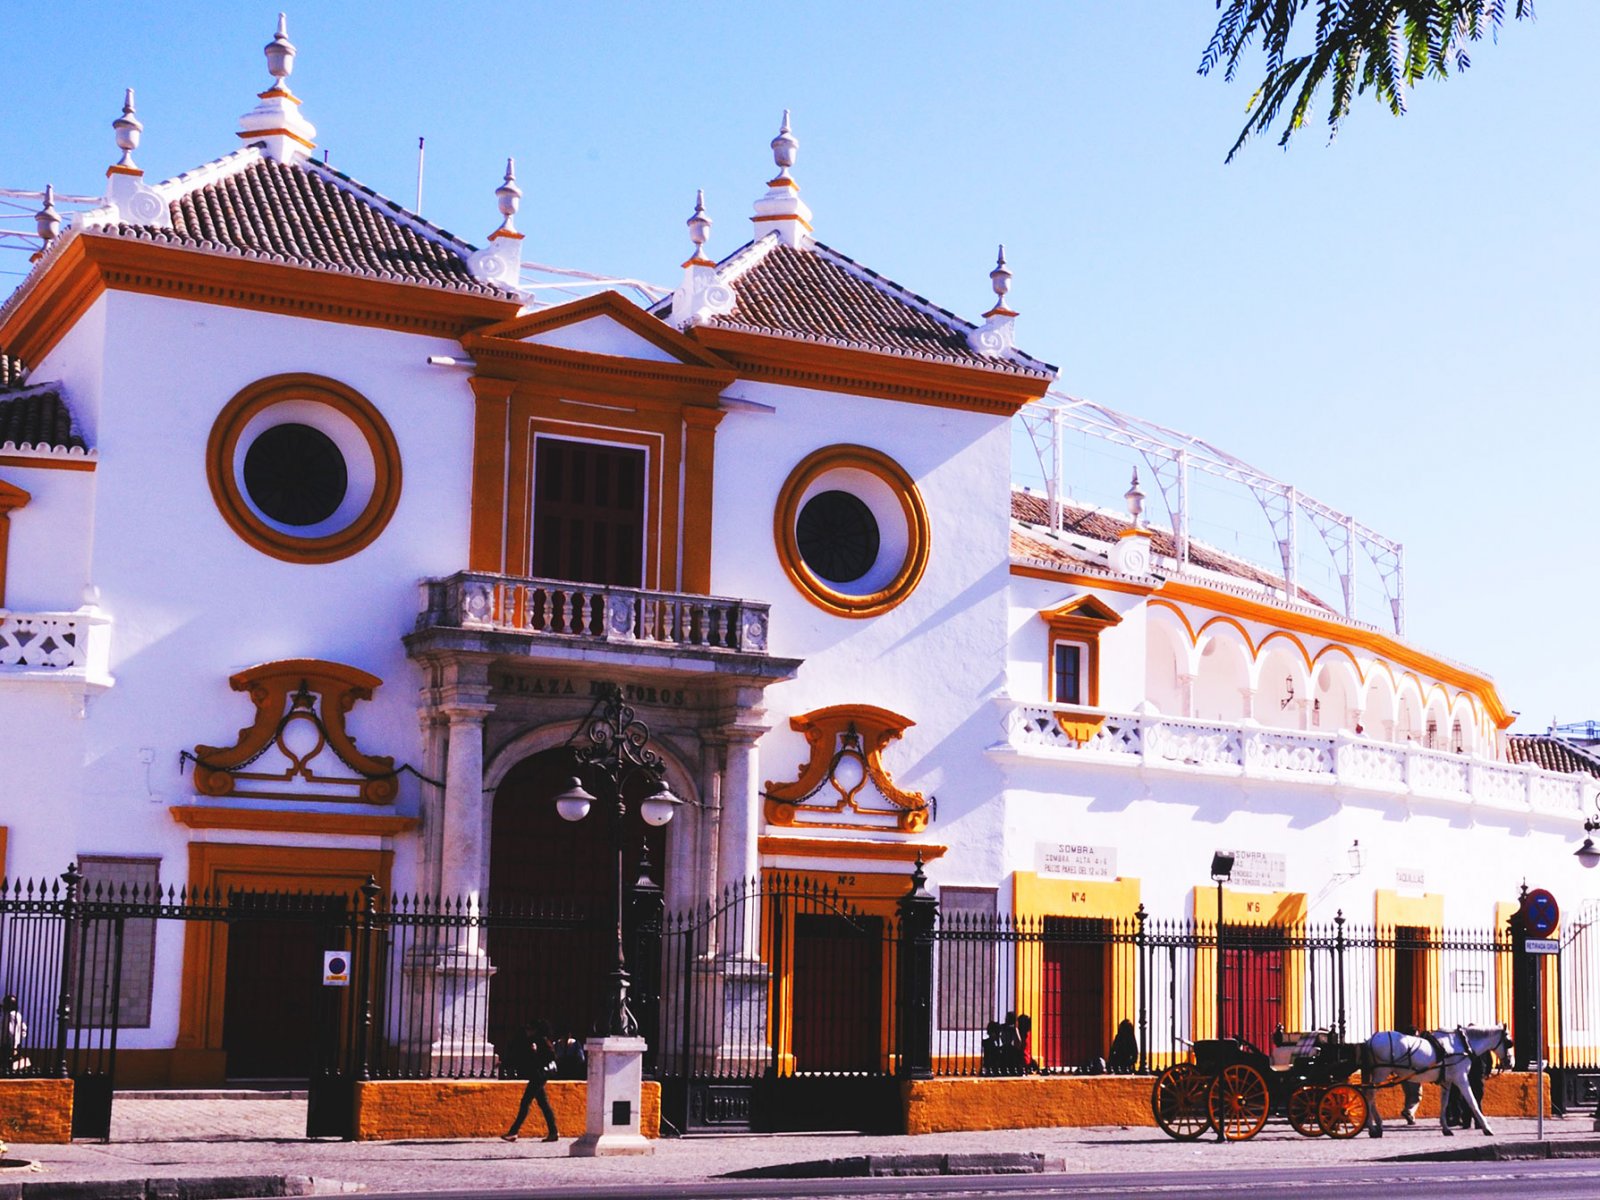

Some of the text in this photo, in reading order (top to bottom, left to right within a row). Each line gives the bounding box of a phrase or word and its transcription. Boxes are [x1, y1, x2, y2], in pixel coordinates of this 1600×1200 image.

[502, 674, 576, 694] PLAZA
[626, 684, 685, 705] TOROS
[1058, 844, 1094, 854] SOMBRA
